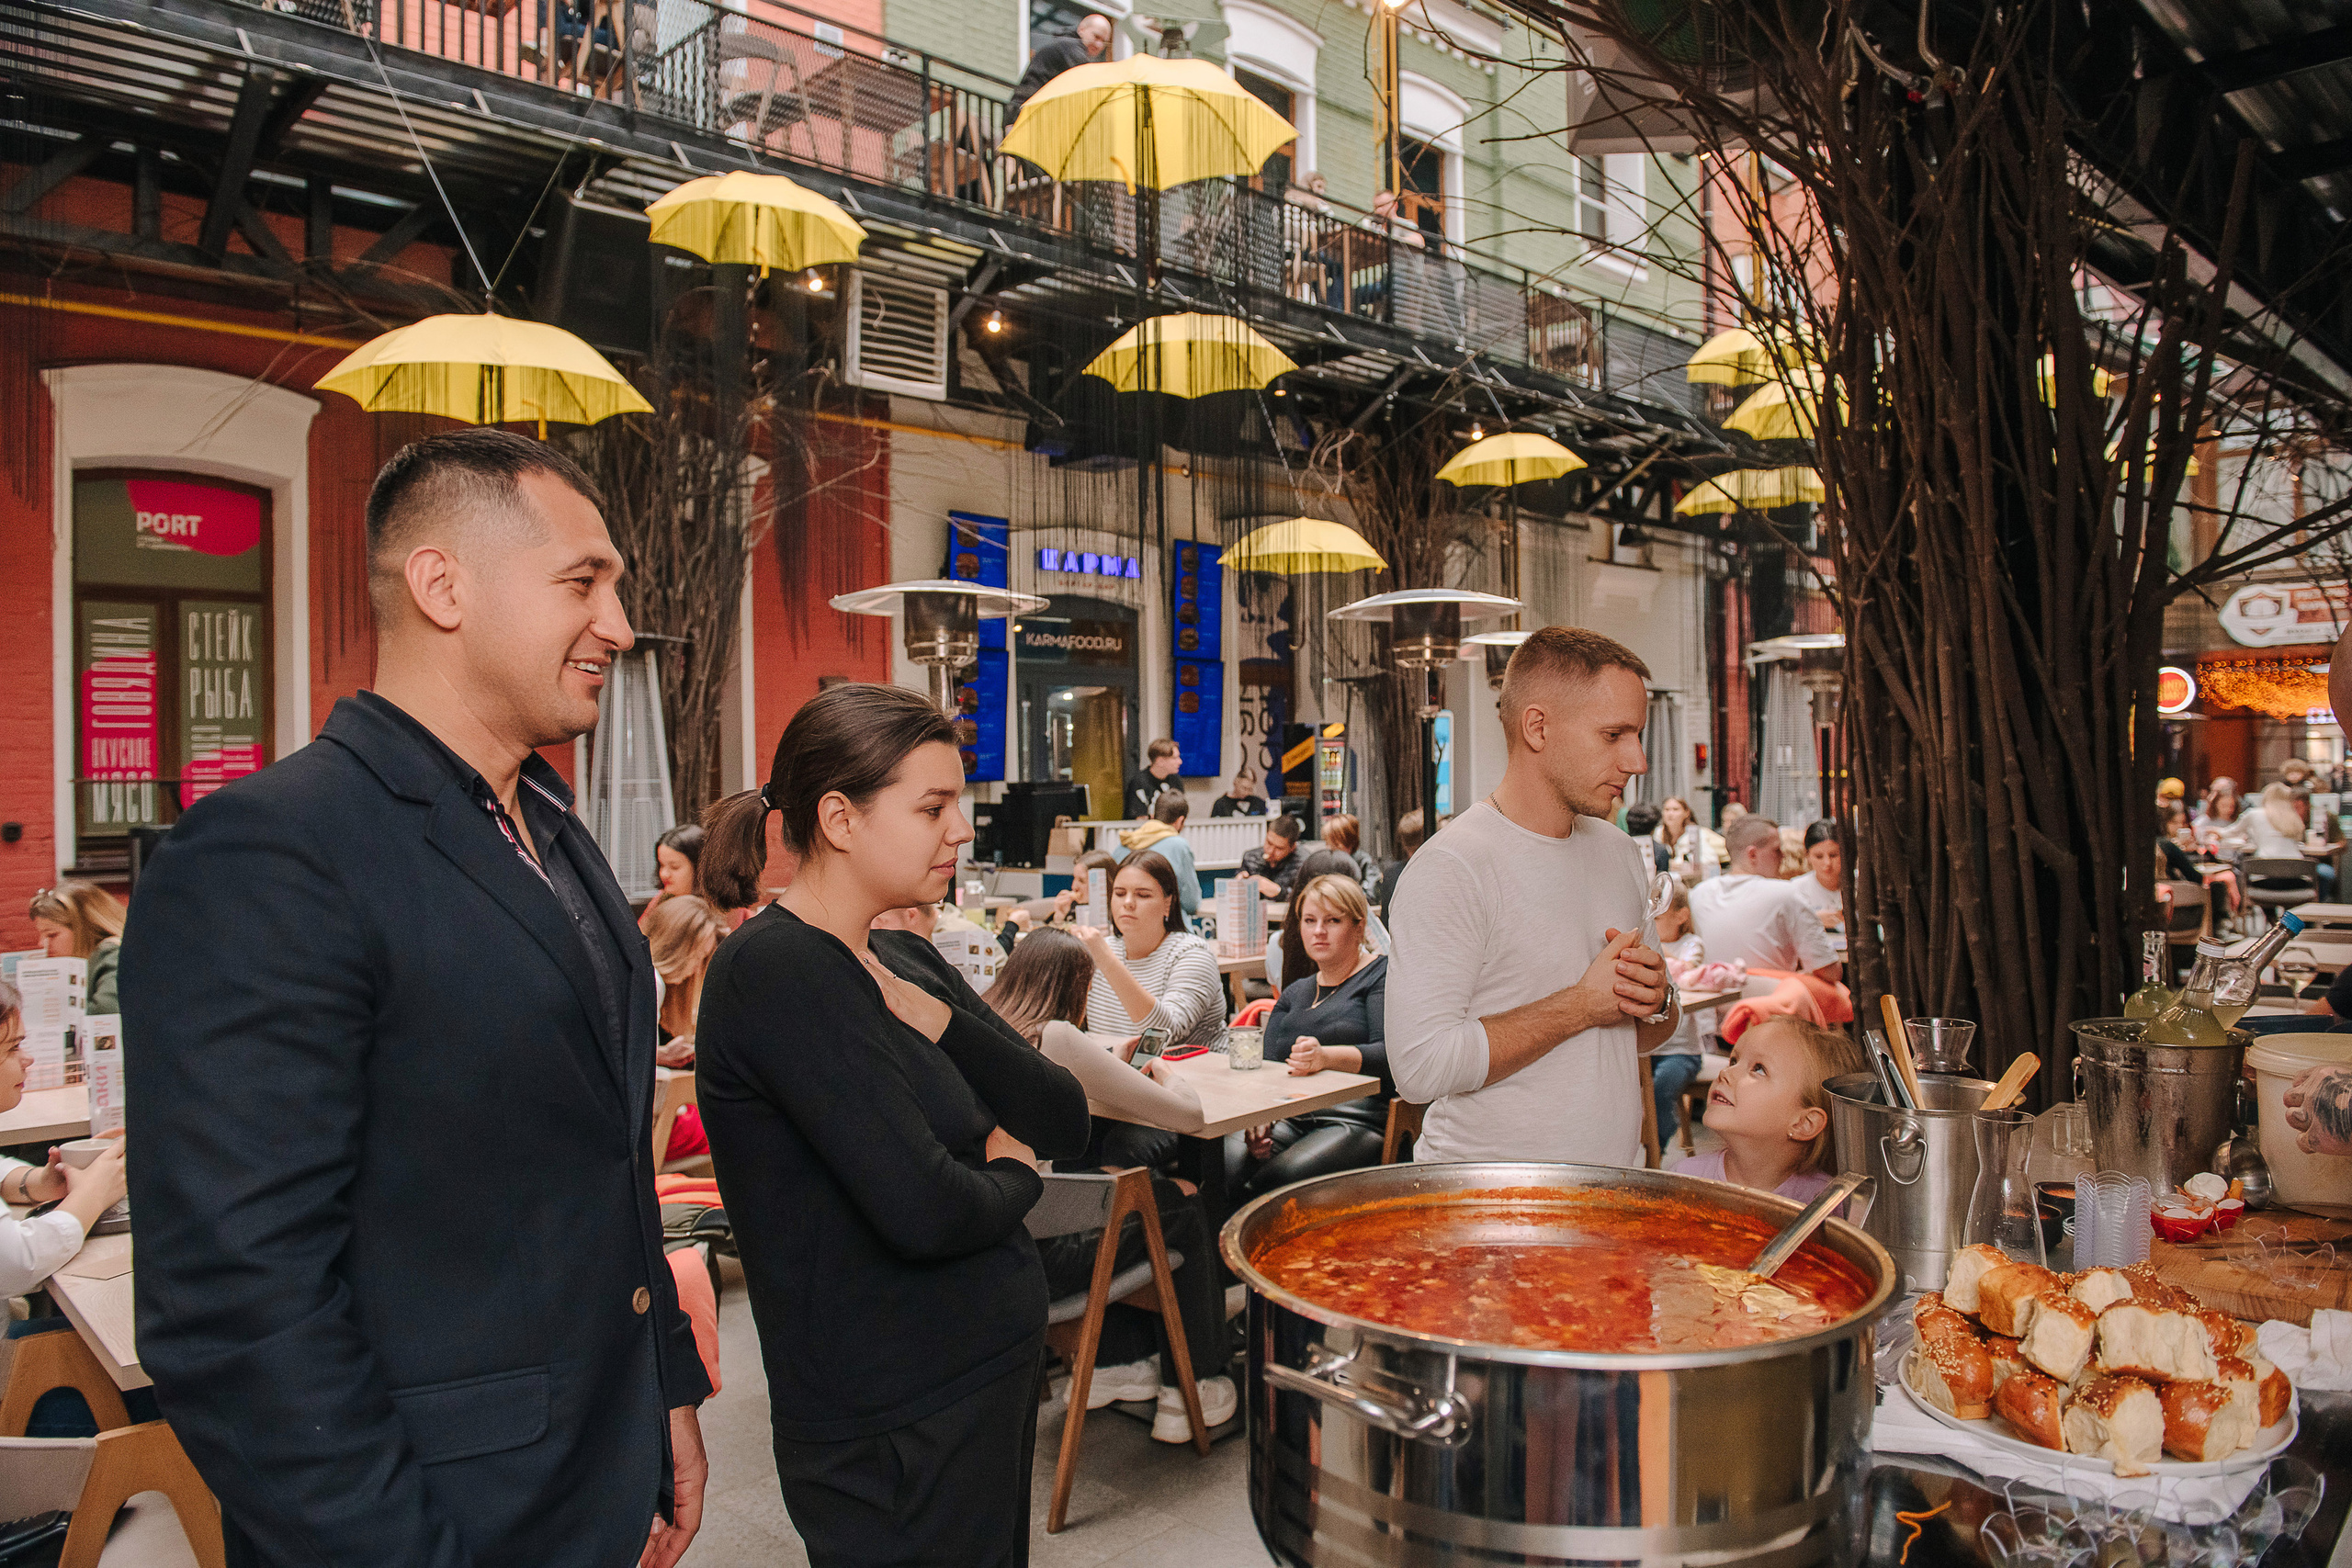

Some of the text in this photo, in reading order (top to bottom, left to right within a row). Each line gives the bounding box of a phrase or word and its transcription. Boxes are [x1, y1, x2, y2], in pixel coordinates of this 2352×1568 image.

[136, 512, 203, 536] PORT
[1040, 547, 1141, 579] КАРМА
[188, 608, 254, 661] СТЕЙК
[91, 616, 155, 728] ГОВЯДИНА
[189, 667, 254, 719] РЫБА
[91, 737, 152, 769] ВКУСНОЕ
[92, 771, 153, 823] МЯСО
